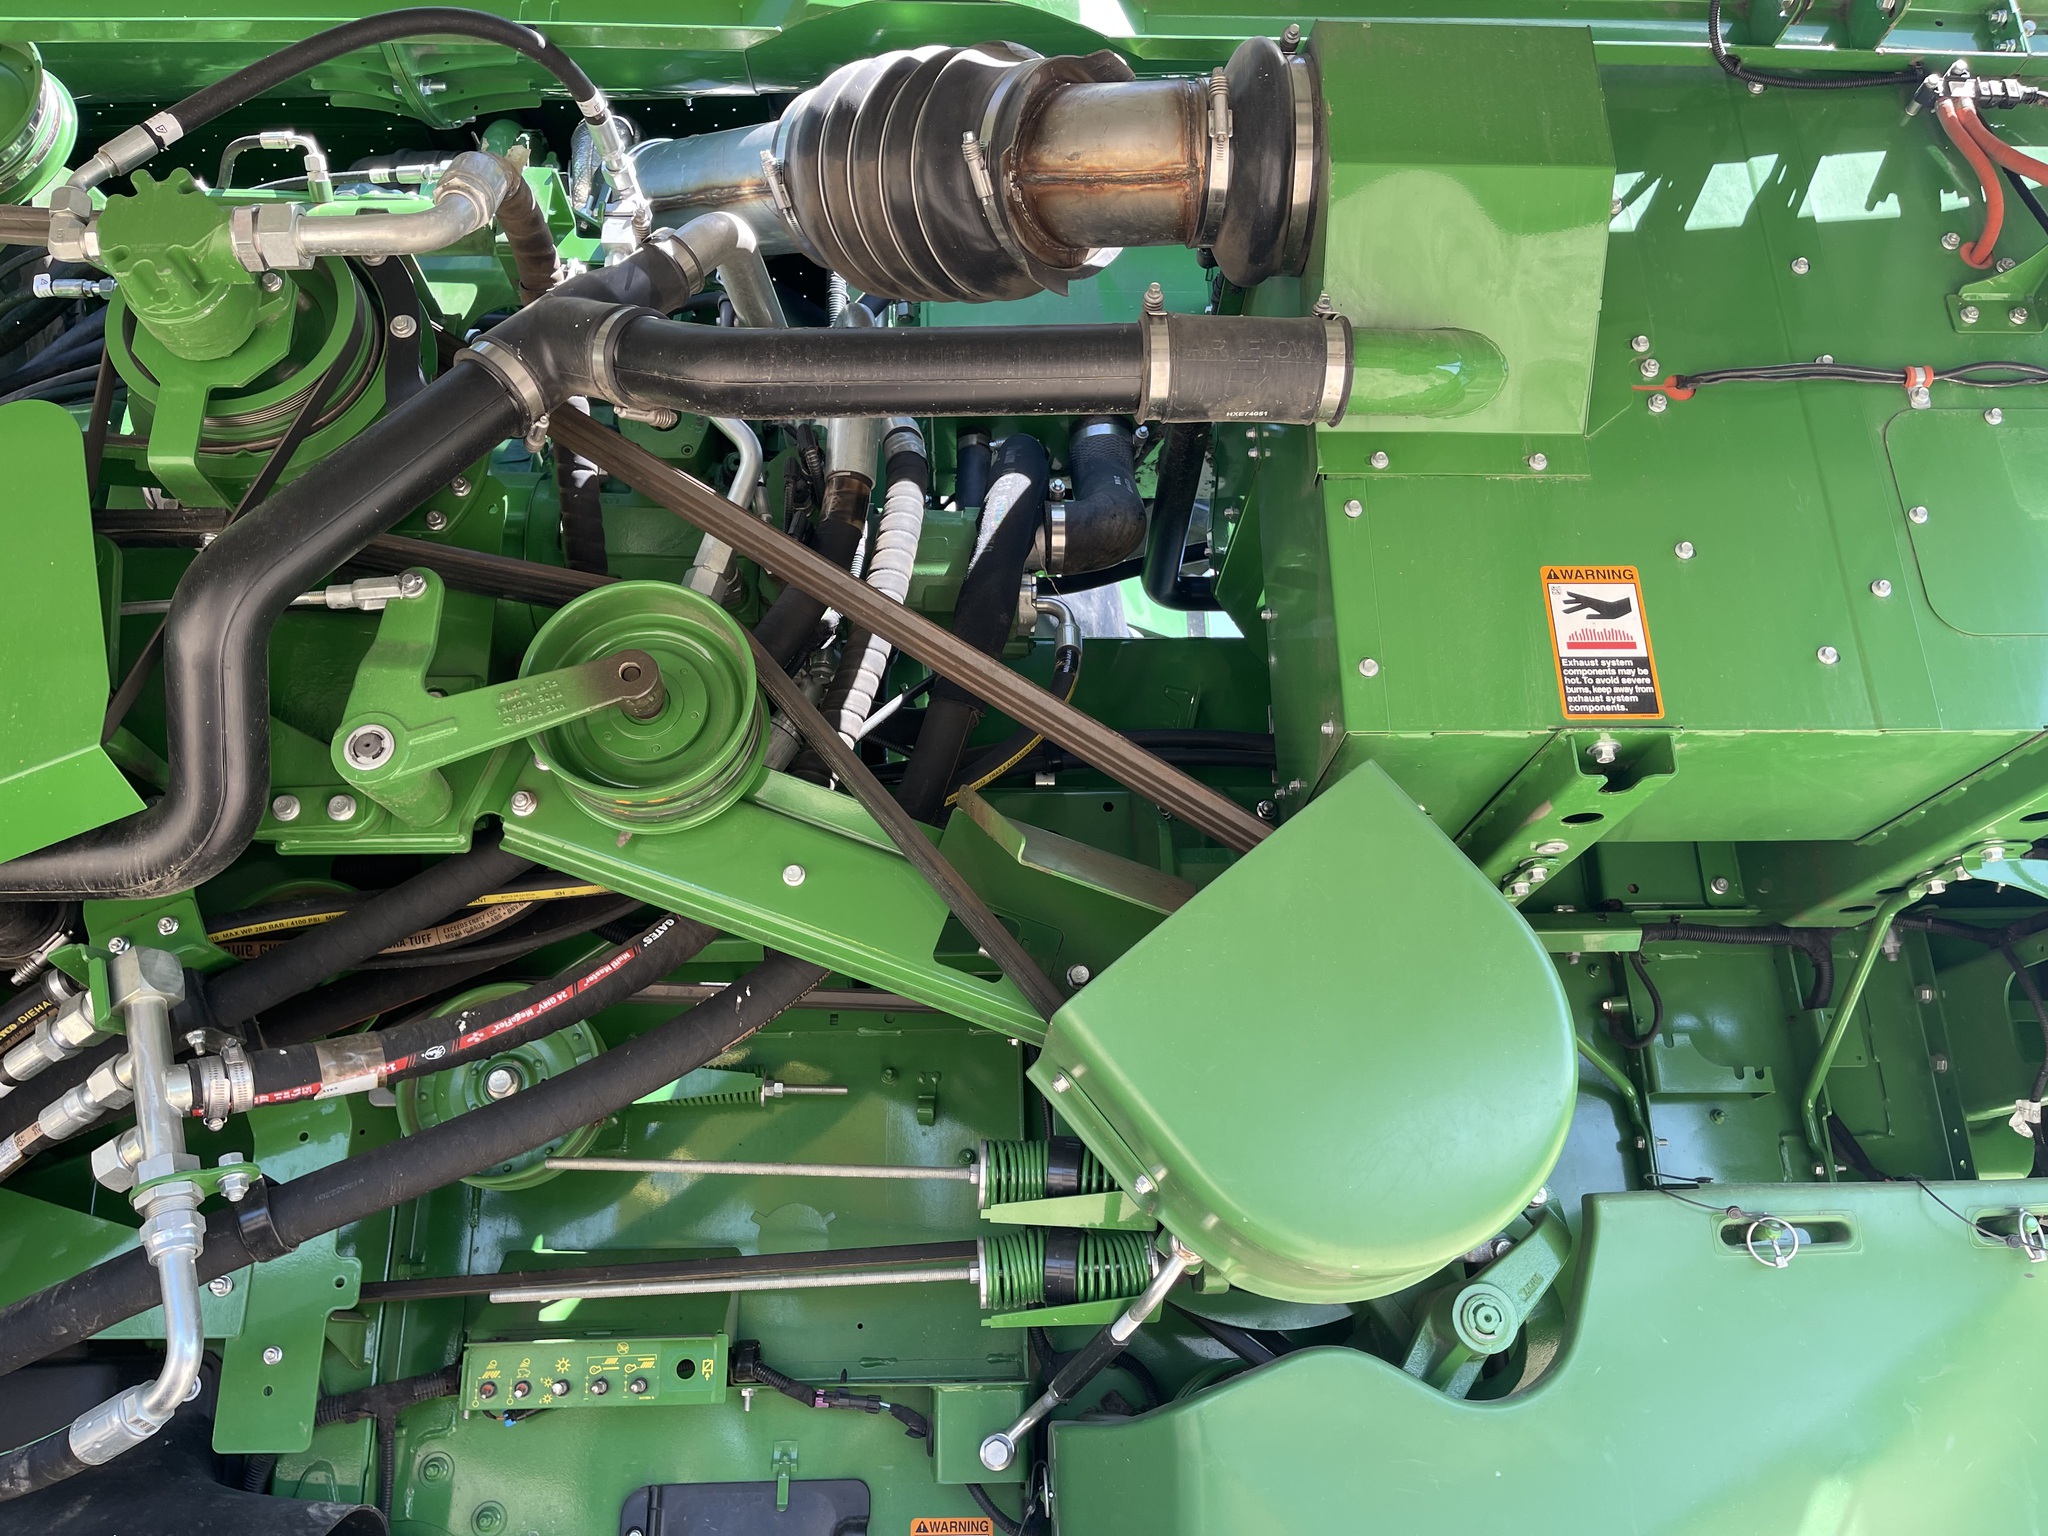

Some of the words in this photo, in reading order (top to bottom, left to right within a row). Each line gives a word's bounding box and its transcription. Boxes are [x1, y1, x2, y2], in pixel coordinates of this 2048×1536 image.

[1559, 569, 1635, 580] WARNING
[1561, 658, 1599, 667] Exhaust
[1600, 658, 1634, 668] system
[1562, 667, 1617, 677] components
[1617, 668, 1636, 677] may
[1637, 667, 1649, 675] be
[1564, 676, 1582, 685] hot.
[1582, 676, 1594, 685] To
[1595, 676, 1620, 685] avoid
[1620, 677, 1651, 685] severe
[1565, 685, 1592, 694] burns,
[1592, 685, 1612, 695] keep
[1613, 686, 1634, 695] away
[1634, 685, 1654, 693] from
[1567, 695, 1604, 703] exhaust
[1605, 695, 1639, 704] system
[1568, 704, 1629, 713] components.
[223, 931, 240, 939] MAX
[268, 922, 285, 931] BAR
[443, 921, 469, 934] EXCEEDS
[643, 918, 675, 946] GATES
[611, 951, 630, 970] Multi
[929, 1520, 989, 1533] WARNING
